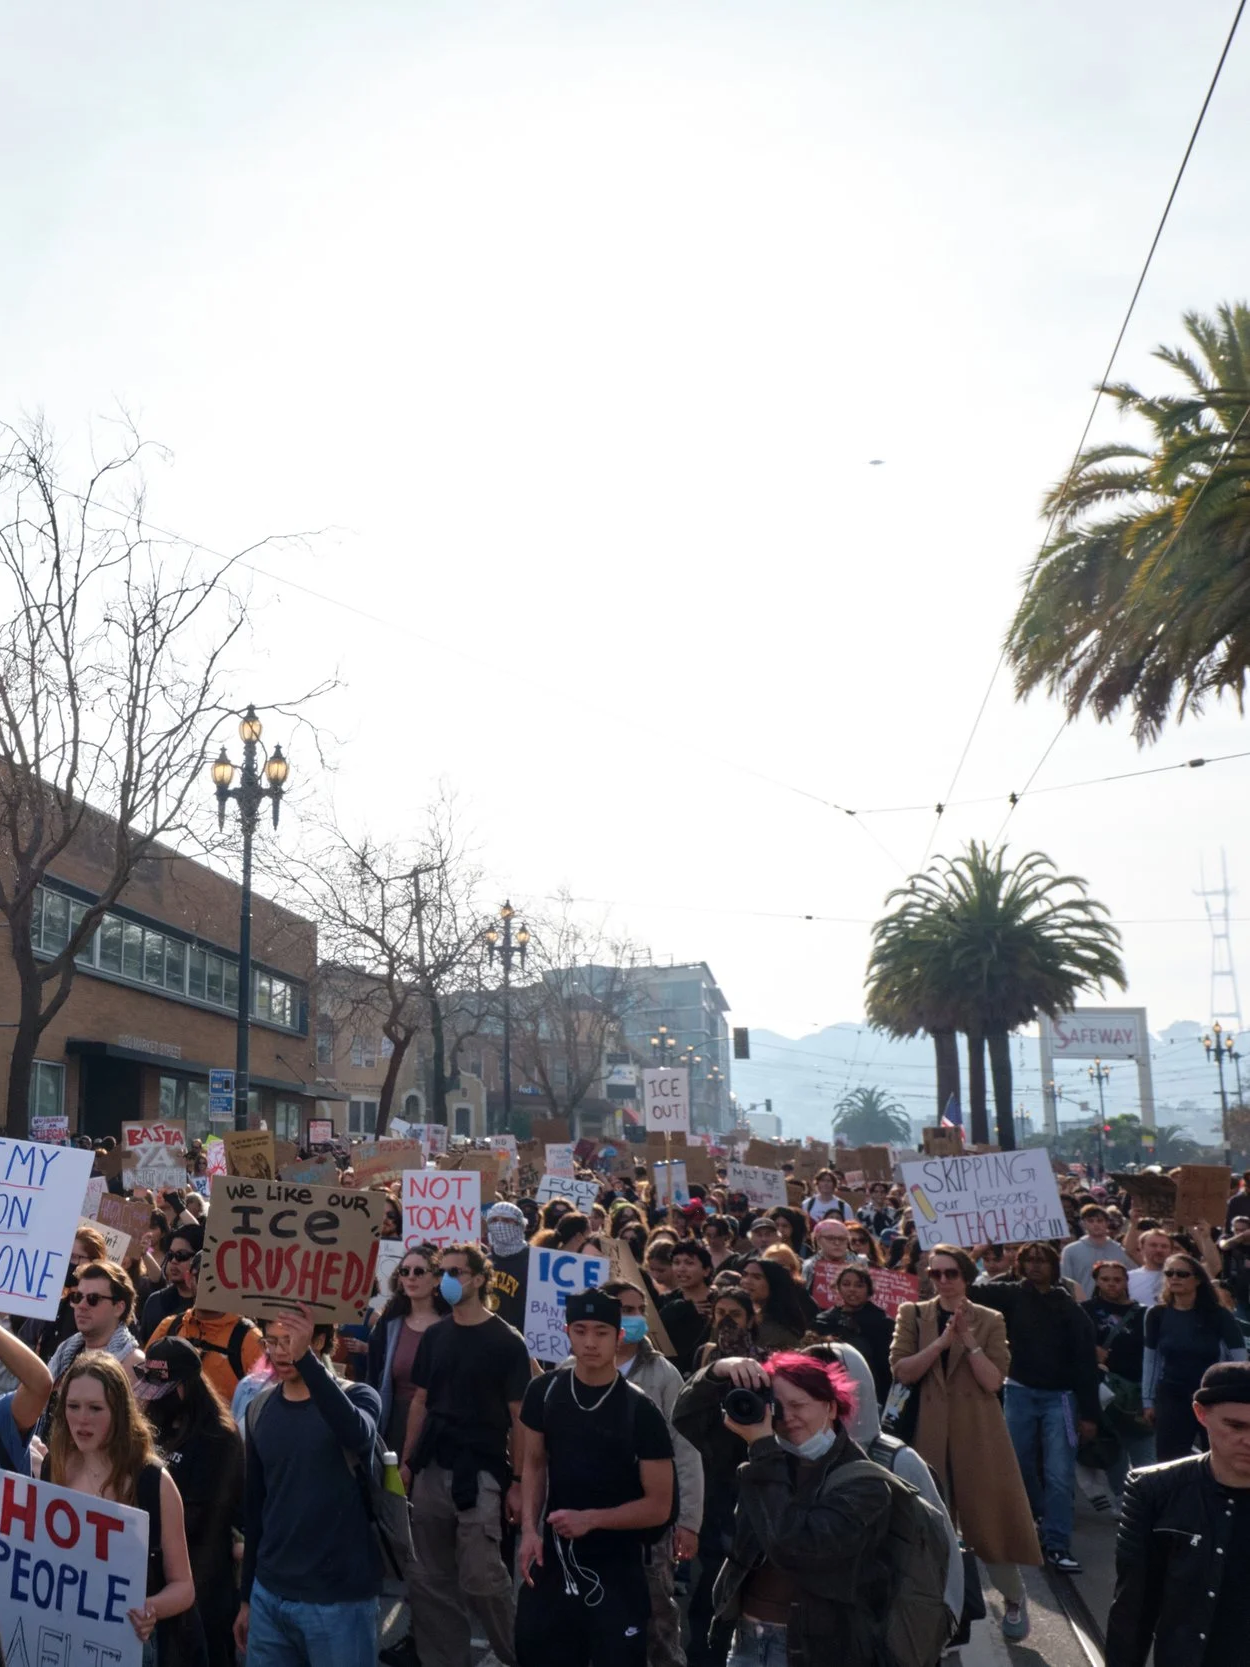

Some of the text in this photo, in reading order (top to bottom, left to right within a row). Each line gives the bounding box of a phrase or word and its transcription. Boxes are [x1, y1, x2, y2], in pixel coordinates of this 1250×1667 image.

[1053, 1020, 1133, 1050] SAFEWAY
[648, 1078, 682, 1097] ICE
[652, 1103, 687, 1120] OUT!
[127, 1125, 184, 1146] BASTA
[5, 1145, 61, 1186] MY
[133, 1146, 175, 1170] YA
[733, 1168, 758, 1180] MELT
[923, 1153, 1037, 1193] SKIPPING
[410, 1177, 472, 1200] NOT
[550, 1178, 596, 1195] FUCK
[935, 1190, 1038, 1213] our lessons
[405, 1204, 475, 1231] TODAY
[945, 1208, 1010, 1246] TEACH
[216, 1238, 380, 1309] CRUSHED!
[539, 1252, 600, 1288] ICE
[547, 1319, 564, 1332] FR
[0, 1477, 124, 1561] HOT
